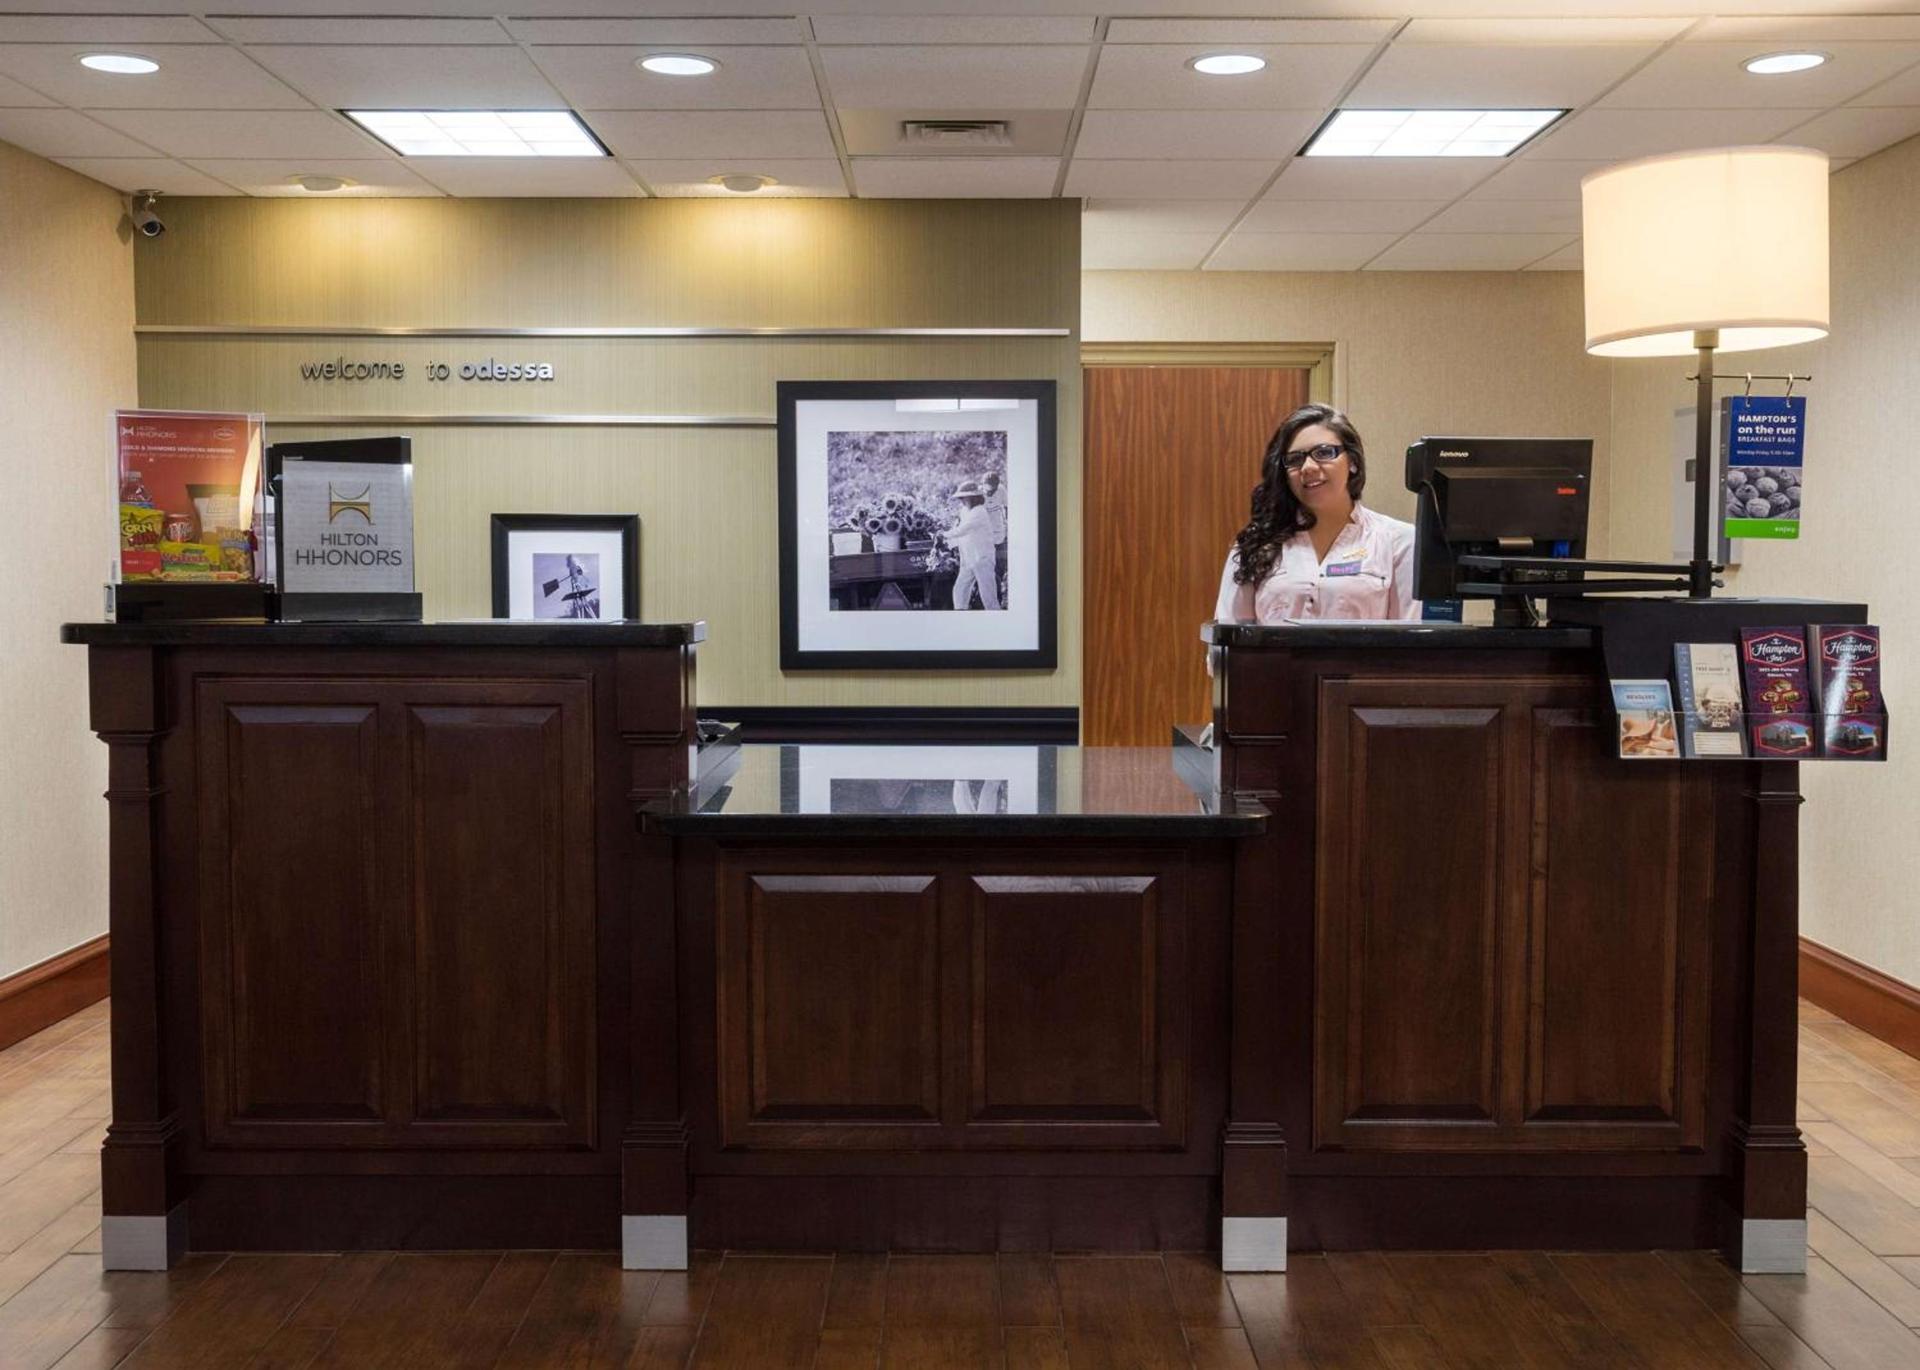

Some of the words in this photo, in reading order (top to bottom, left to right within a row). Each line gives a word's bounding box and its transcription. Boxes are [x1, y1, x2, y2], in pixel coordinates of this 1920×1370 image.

[302, 357, 405, 379] welcome
[426, 360, 450, 380] to
[459, 358, 554, 380] odessa
[1738, 415, 1797, 423] HAMPTON'S
[1738, 426, 1753, 434] on
[1755, 425, 1774, 434] the
[1439, 450, 1469, 458] lenovo
[121, 520, 153, 537] CORN
[320, 532, 379, 547] HILTON
[296, 549, 403, 566] HHONORS
[1752, 643, 1802, 657] Hampton
[1824, 641, 1876, 655] Hampton
[1767, 654, 1785, 662] Inn
